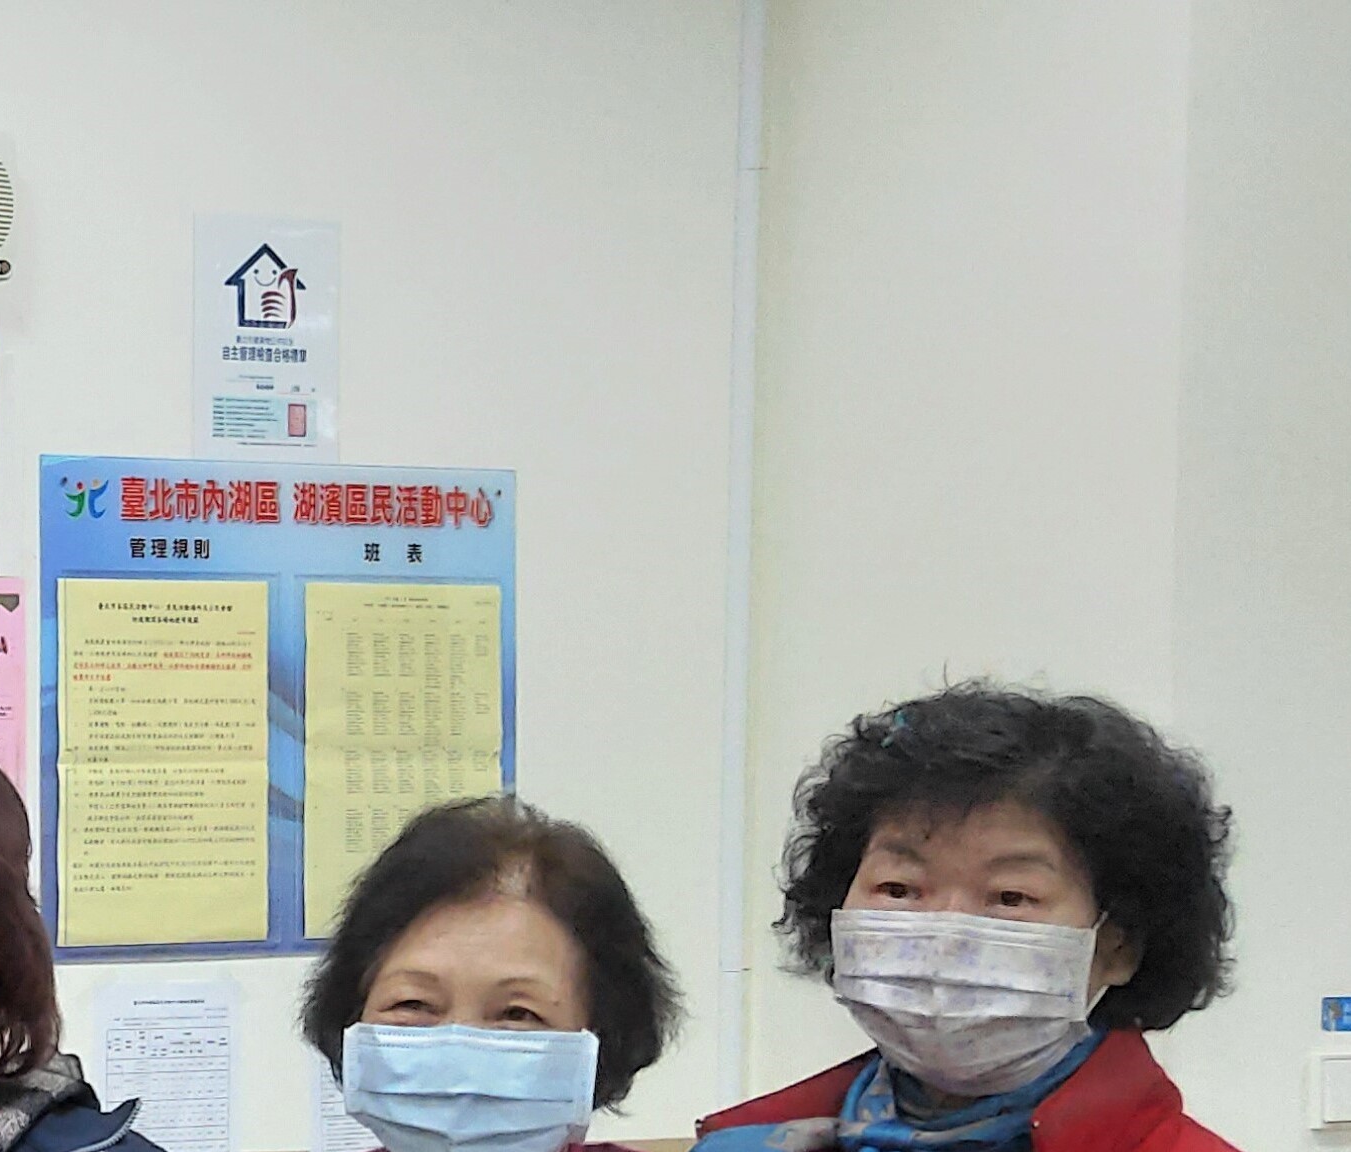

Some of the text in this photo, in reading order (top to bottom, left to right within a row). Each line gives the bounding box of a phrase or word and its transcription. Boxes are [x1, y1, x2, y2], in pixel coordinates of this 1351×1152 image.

[120, 476, 494, 529] 臺北市內湖區 湖濱區民活動中心
[129, 538, 211, 560] 管理規則
